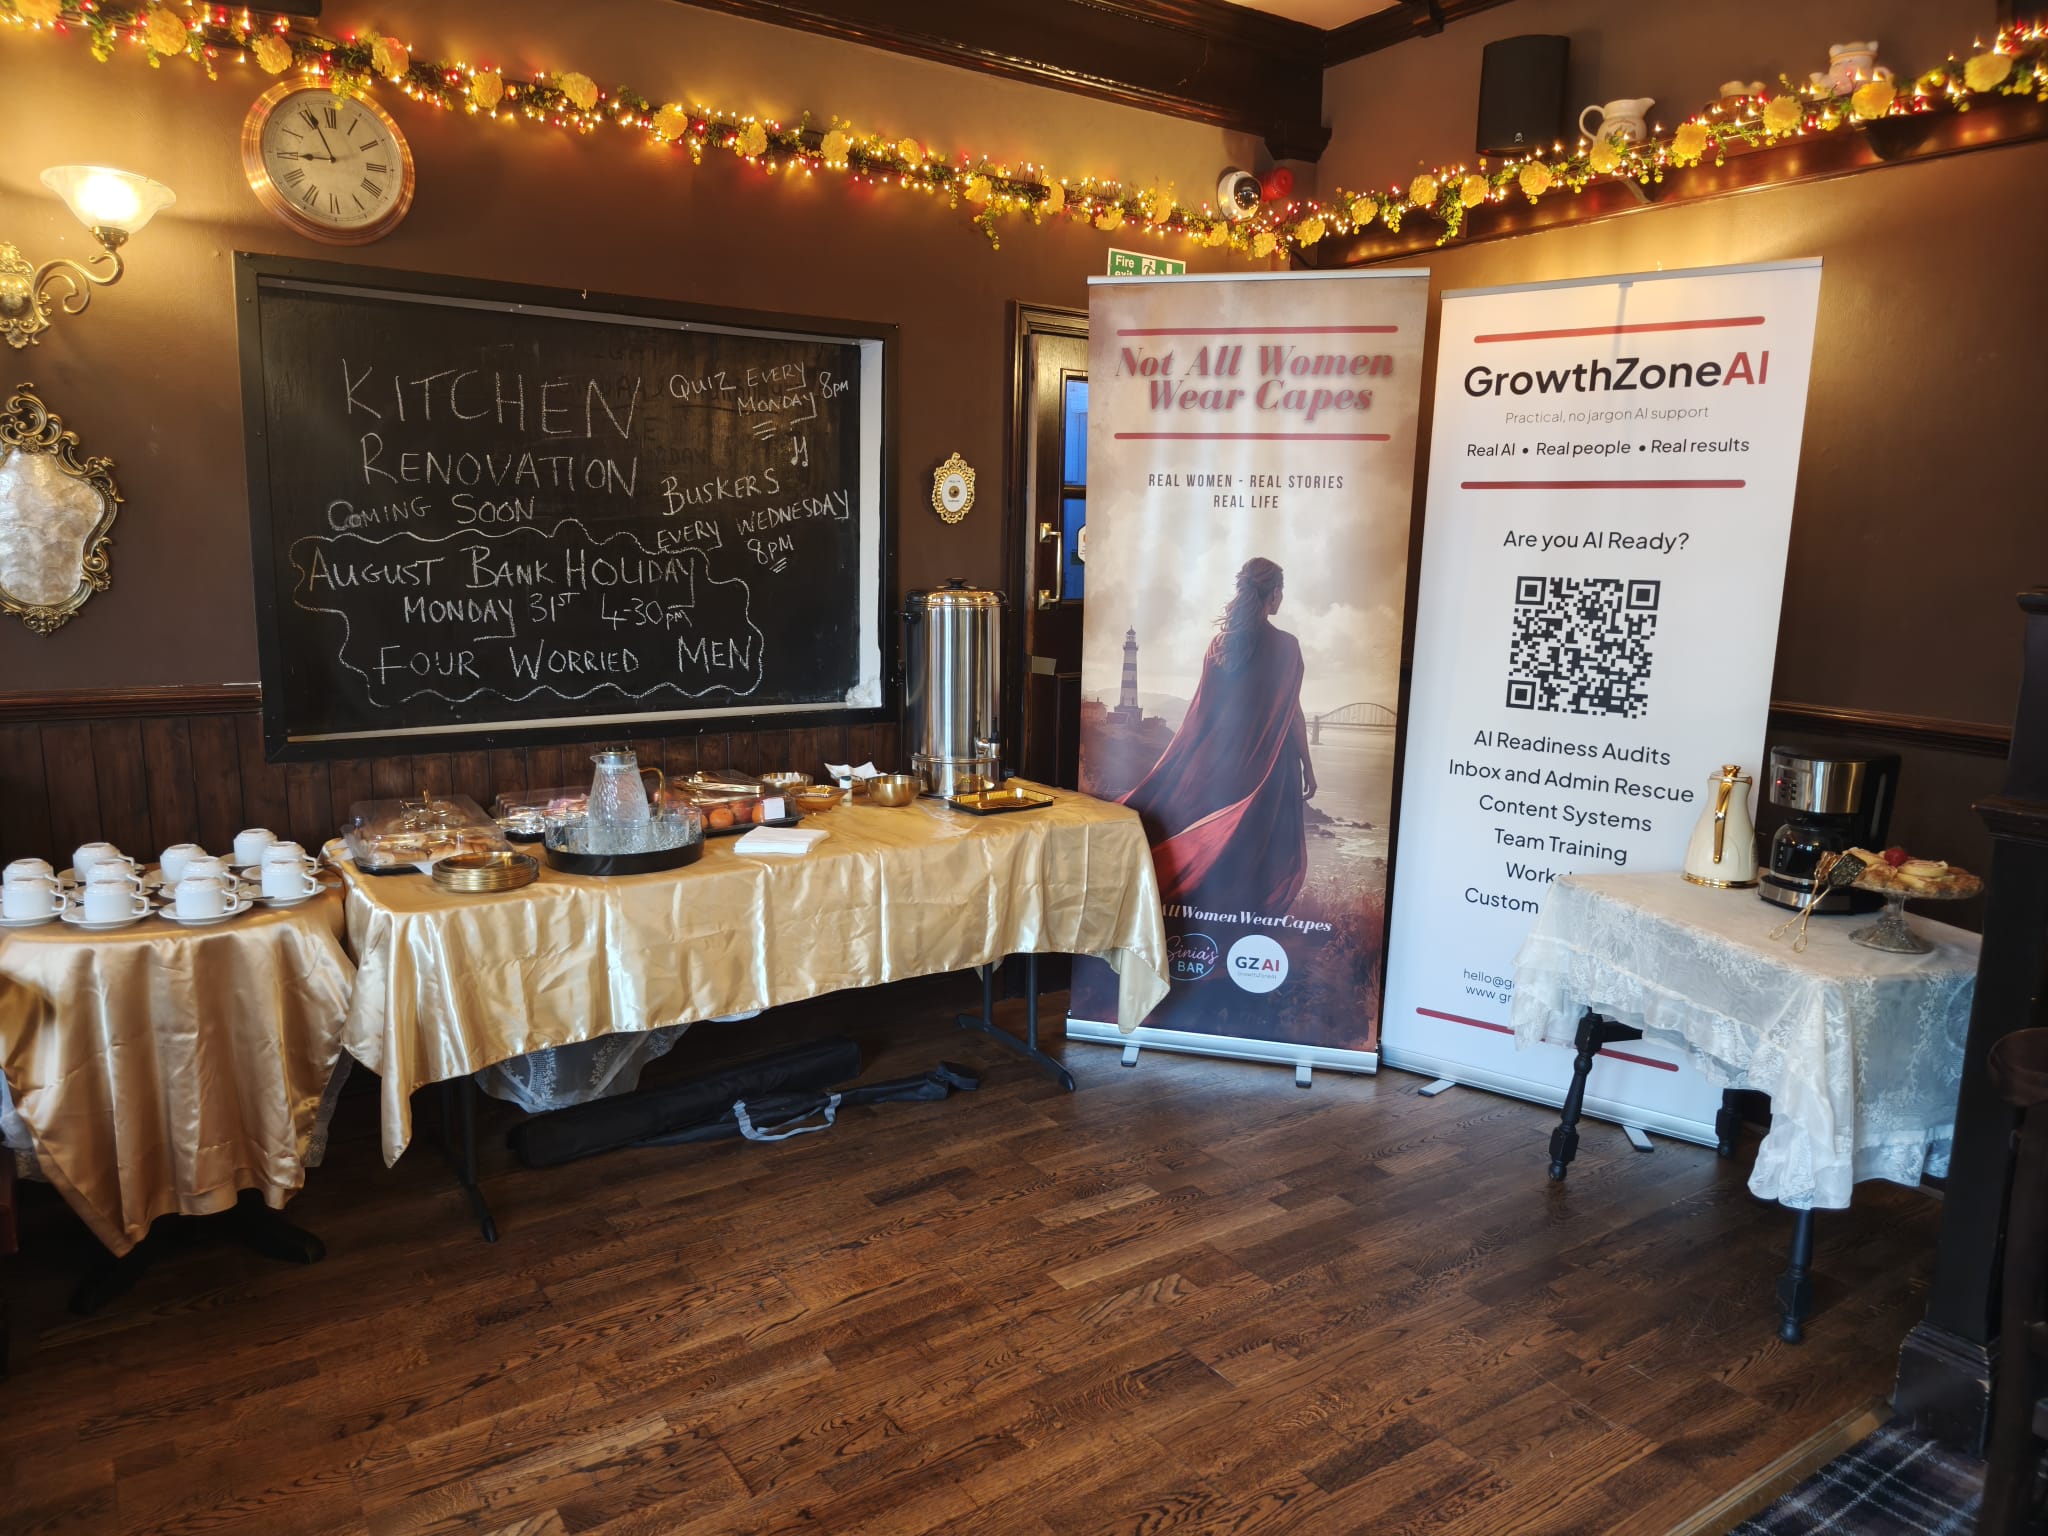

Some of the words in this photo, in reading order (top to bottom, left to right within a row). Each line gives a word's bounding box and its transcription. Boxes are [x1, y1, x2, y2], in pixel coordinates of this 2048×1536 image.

[1115, 254, 1135, 268] Fire
[747, 360, 807, 391] EVERY
[1115, 346, 1174, 377] Not
[1186, 345, 1244, 377] All
[1258, 345, 1394, 377] Women
[1464, 350, 1770, 398] GrowthZoneAI
[342, 358, 641, 439] KITCHEN
[737, 392, 818, 425] MONDAY
[1148, 380, 1244, 411] Wear
[1256, 380, 1373, 421] Capes
[1505, 409, 1566, 425] Practical,
[1568, 411, 1585, 422] no
[1586, 409, 1632, 425] jargon
[1634, 408, 1648, 420] AI
[1651, 407, 1709, 421] support
[360, 433, 638, 496] RENOVATION
[1466, 443, 1499, 457] Real
[1501, 443, 1516, 456] AI
[1536, 441, 1570, 456] Real
[1572, 440, 1631, 457] people
[1651, 439, 1687, 453] Real
[1689, 438, 1750, 453] results
[661, 467, 780, 516] BUSKERS
[1148, 473, 1180, 488] REAL
[1186, 474, 1233, 488] WOMEN
[1250, 474, 1282, 489] REAL
[1288, 475, 1344, 490] STORIES
[328, 496, 431, 531] COMING
[452, 493, 535, 525] SOON
[657, 520, 723, 551] EVERY
[736, 489, 850, 536] WEDNESDAY
[1213, 494, 1245, 509] REAL
[1251, 495, 1279, 510] LIFE
[1503, 530, 1537, 548] Are
[1541, 533, 1579, 552] you
[1583, 531, 1603, 549] AI
[1608, 531, 1690, 555] Ready?
[310, 546, 446, 593] AUGUST
[460, 544, 559, 588] BANK
[566, 548, 695, 609] HOLIDAY
[404, 595, 516, 642] MONDAY
[374, 645, 480, 684] FOUR
[509, 639, 639, 680] WORRIED
[677, 635, 754, 674] MEN
[1474, 730, 1493, 747] AI
[1497, 732, 1598, 758] Readiness
[1602, 743, 1671, 766] Audits
[1449, 759, 1501, 780] Inbox
[1505, 767, 1541, 785] and
[1544, 770, 1609, 793] Admin
[1614, 778, 1694, 803] Rescue
[1479, 795, 1558, 820] Content
[1562, 805, 1652, 832] Systems
[1494, 828, 1545, 850] Team
[1549, 836, 1628, 866] Training
[1506, 862, 1572, 883] Work
[1464, 887, 1539, 914] Custom
[1178, 960, 1204, 974] BAR
[1466, 985, 1512, 1004] wwwgr
